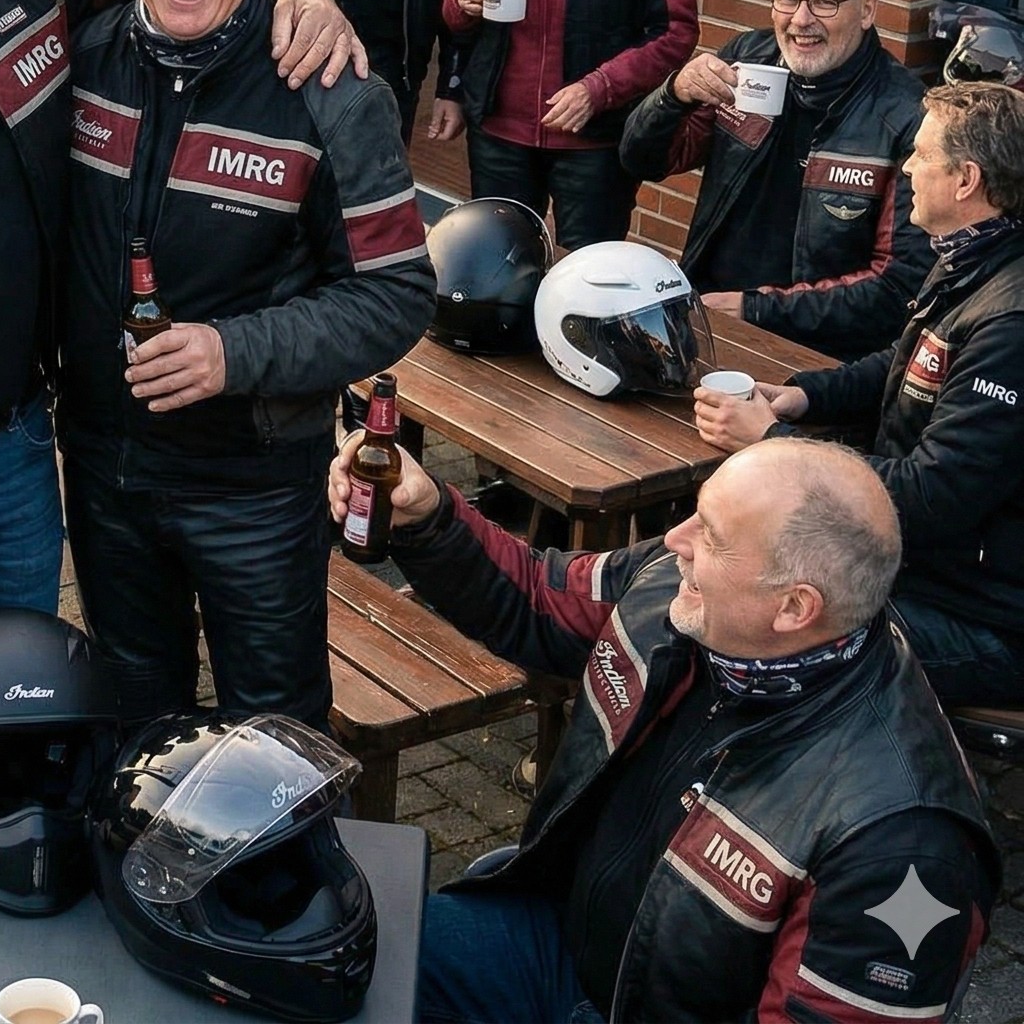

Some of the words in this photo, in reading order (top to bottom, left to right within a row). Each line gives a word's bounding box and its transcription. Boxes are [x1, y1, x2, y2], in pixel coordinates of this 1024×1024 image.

[12, 34, 64, 88] IMRG
[208, 146, 285, 186] IMRG
[828, 166, 874, 186] IMRG
[972, 377, 1018, 406] IMRG
[596, 640, 631, 709] Indian
[703, 832, 773, 905] IMRG
